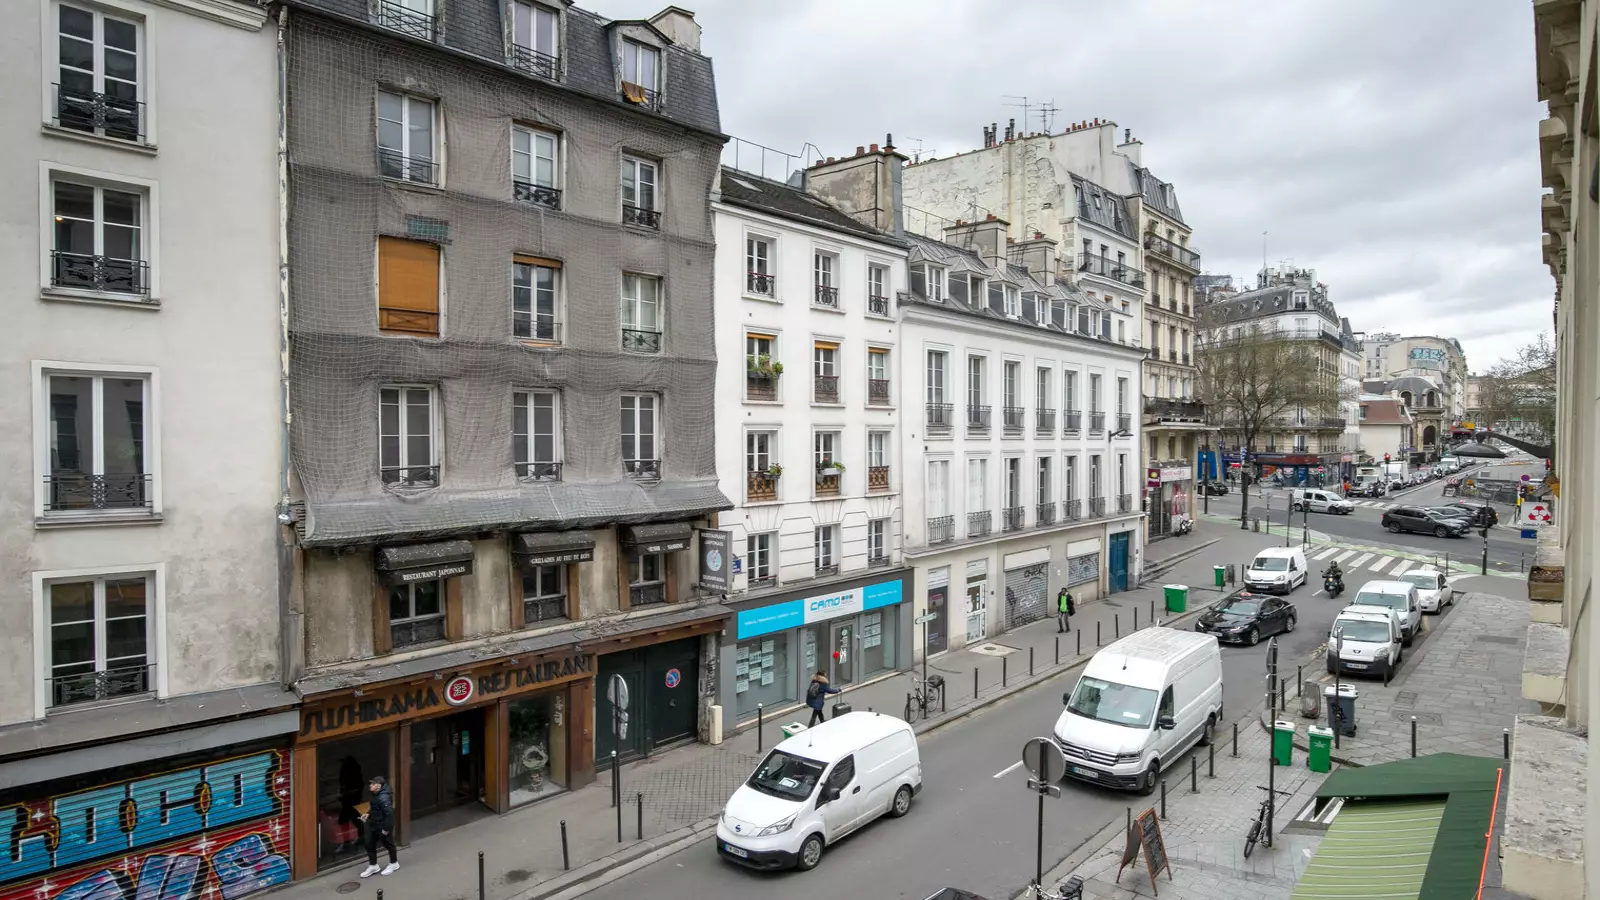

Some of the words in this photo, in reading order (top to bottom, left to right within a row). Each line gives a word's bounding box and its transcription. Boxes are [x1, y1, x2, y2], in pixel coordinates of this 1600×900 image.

[403, 570, 437, 580] RESTAURANT
[810, 596, 841, 612] CAMO
[301, 686, 440, 736] SUSHIRAMA
[478, 653, 595, 696] RESTAURANT
